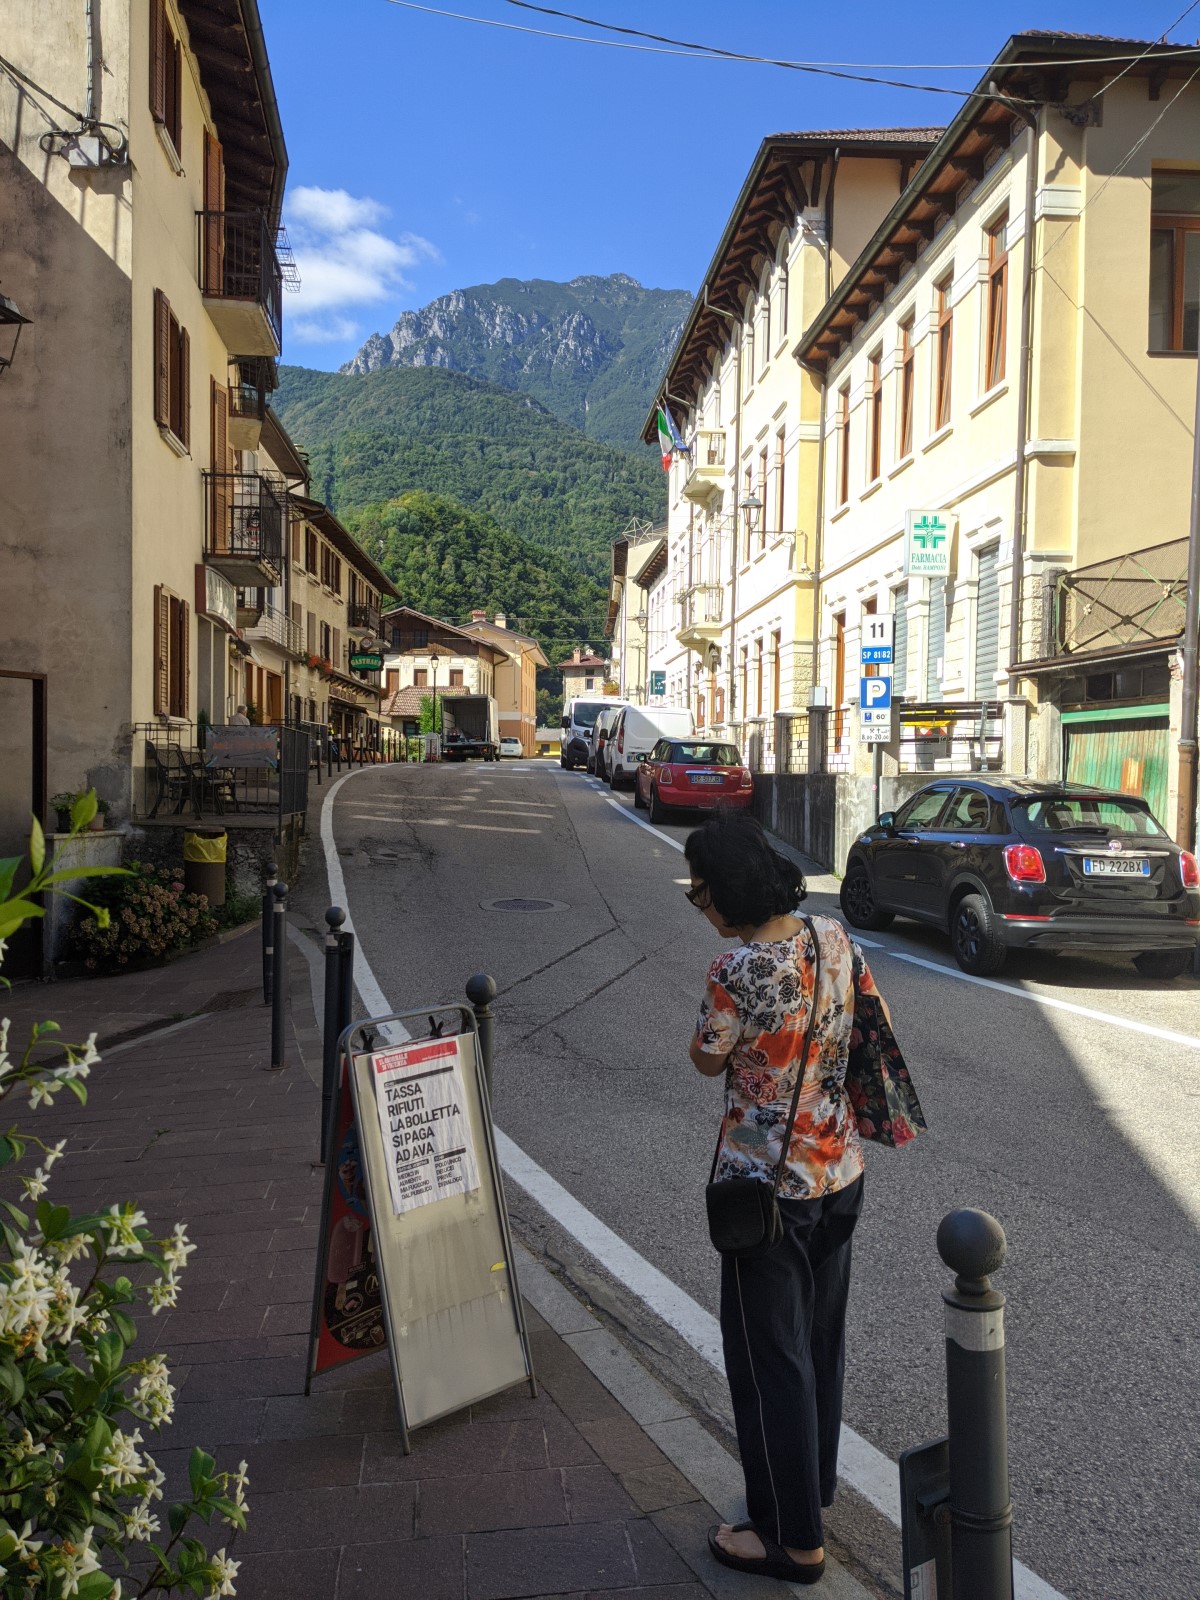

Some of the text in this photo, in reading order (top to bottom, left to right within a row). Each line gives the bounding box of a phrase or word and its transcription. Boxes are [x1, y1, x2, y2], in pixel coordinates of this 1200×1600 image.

[911, 552, 947, 564] FARMACIA
[870, 622, 884, 638] 11
[862, 651, 872, 659] SP
[866, 680, 886, 706] P
[1092, 860, 1142, 872] FD 222BX
[384, 1082, 422, 1102] TASSA
[387, 1097, 424, 1117] RIFIUTI
[390, 1103, 460, 1132] LA BOLLETTA
[392, 1126, 435, 1148] SI PAGA
[396, 1149, 410, 1163] AD
[412, 1142, 434, 1159] AVA
